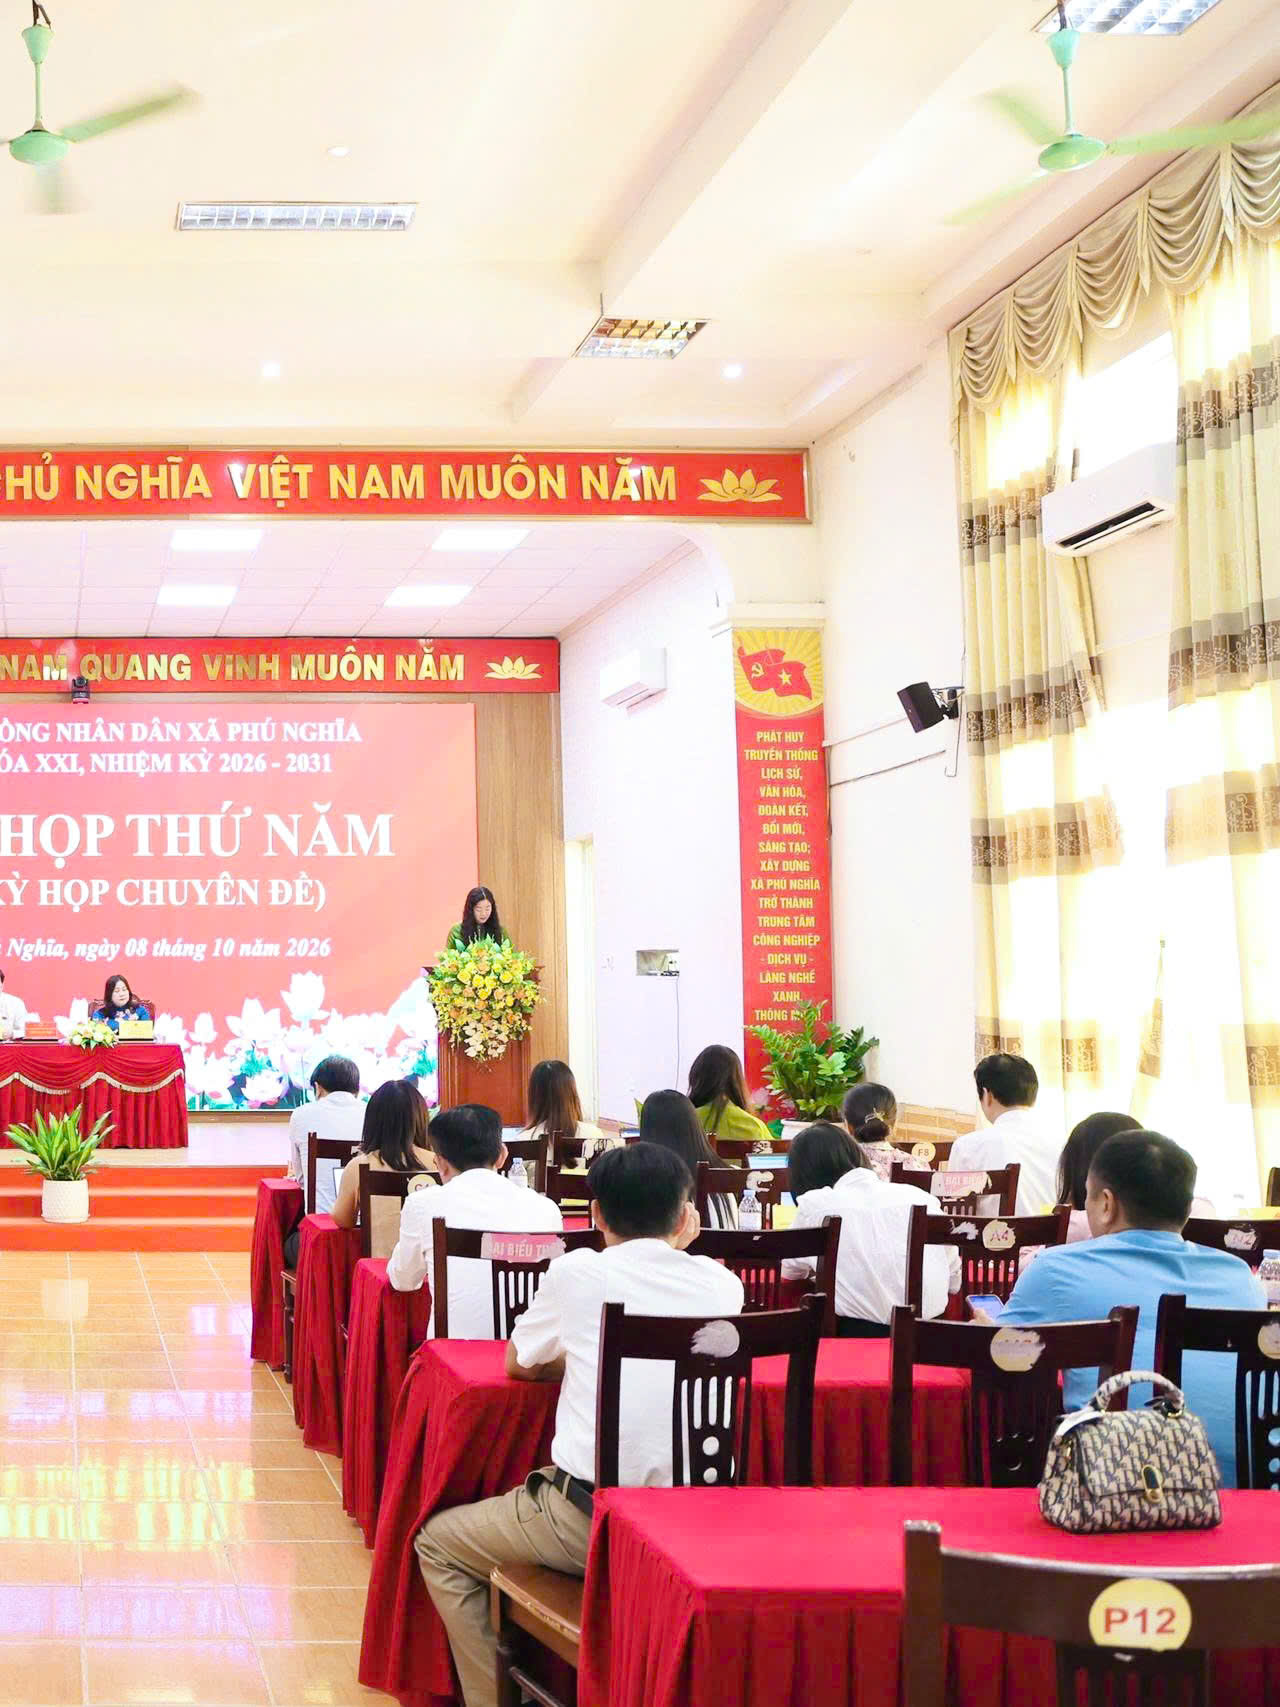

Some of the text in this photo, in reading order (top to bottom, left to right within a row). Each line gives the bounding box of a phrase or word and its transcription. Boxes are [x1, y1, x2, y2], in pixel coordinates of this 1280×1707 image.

[75, 456, 213, 501] NGHĨA
[227, 455, 313, 508] VIỆT
[329, 463, 425, 501] NAM
[441, 453, 566, 501] MUÔN
[582, 457, 677, 502] NĂM
[80, 653, 192, 682] QUANG
[203, 653, 280, 682] VINH
[291, 645, 386, 682] MUÔN
[395, 643, 465, 682] NĂM
[57, 720, 126, 743] NHÂN
[132, 718, 182, 743] DÂN
[187, 719, 221, 743] XÃ
[228, 718, 276, 743] PHÚ
[281, 719, 362, 743] NGHĨA
[785, 732, 804, 742] HUY
[36, 753, 85, 778] XXI,
[90, 751, 172, 778] NHIỆM
[178, 750, 213, 773] KỲ
[220, 753, 266, 773] 2026
[286, 753, 332, 773] 2031
[126, 801, 252, 857] THỨ
[264, 802, 395, 857] NĂM
[38, 879, 109, 913] HỌP
[117, 873, 259, 906] CHUYÊN
[269, 871, 327, 913] ĐỀ)
[758, 916, 791, 927] TRUNG
[6, 937, 67, 961] Nghĩa,
[75, 938, 120, 964] ngày
[125, 938, 148, 958] 08
[153, 937, 207, 964] tháng
[213, 938, 235, 958] 10
[240, 938, 281, 958] năm
[287, 937, 331, 958] 2026
[794, 954, 807, 967] VỤ
[1104, 1607, 1176, 1634] P12
